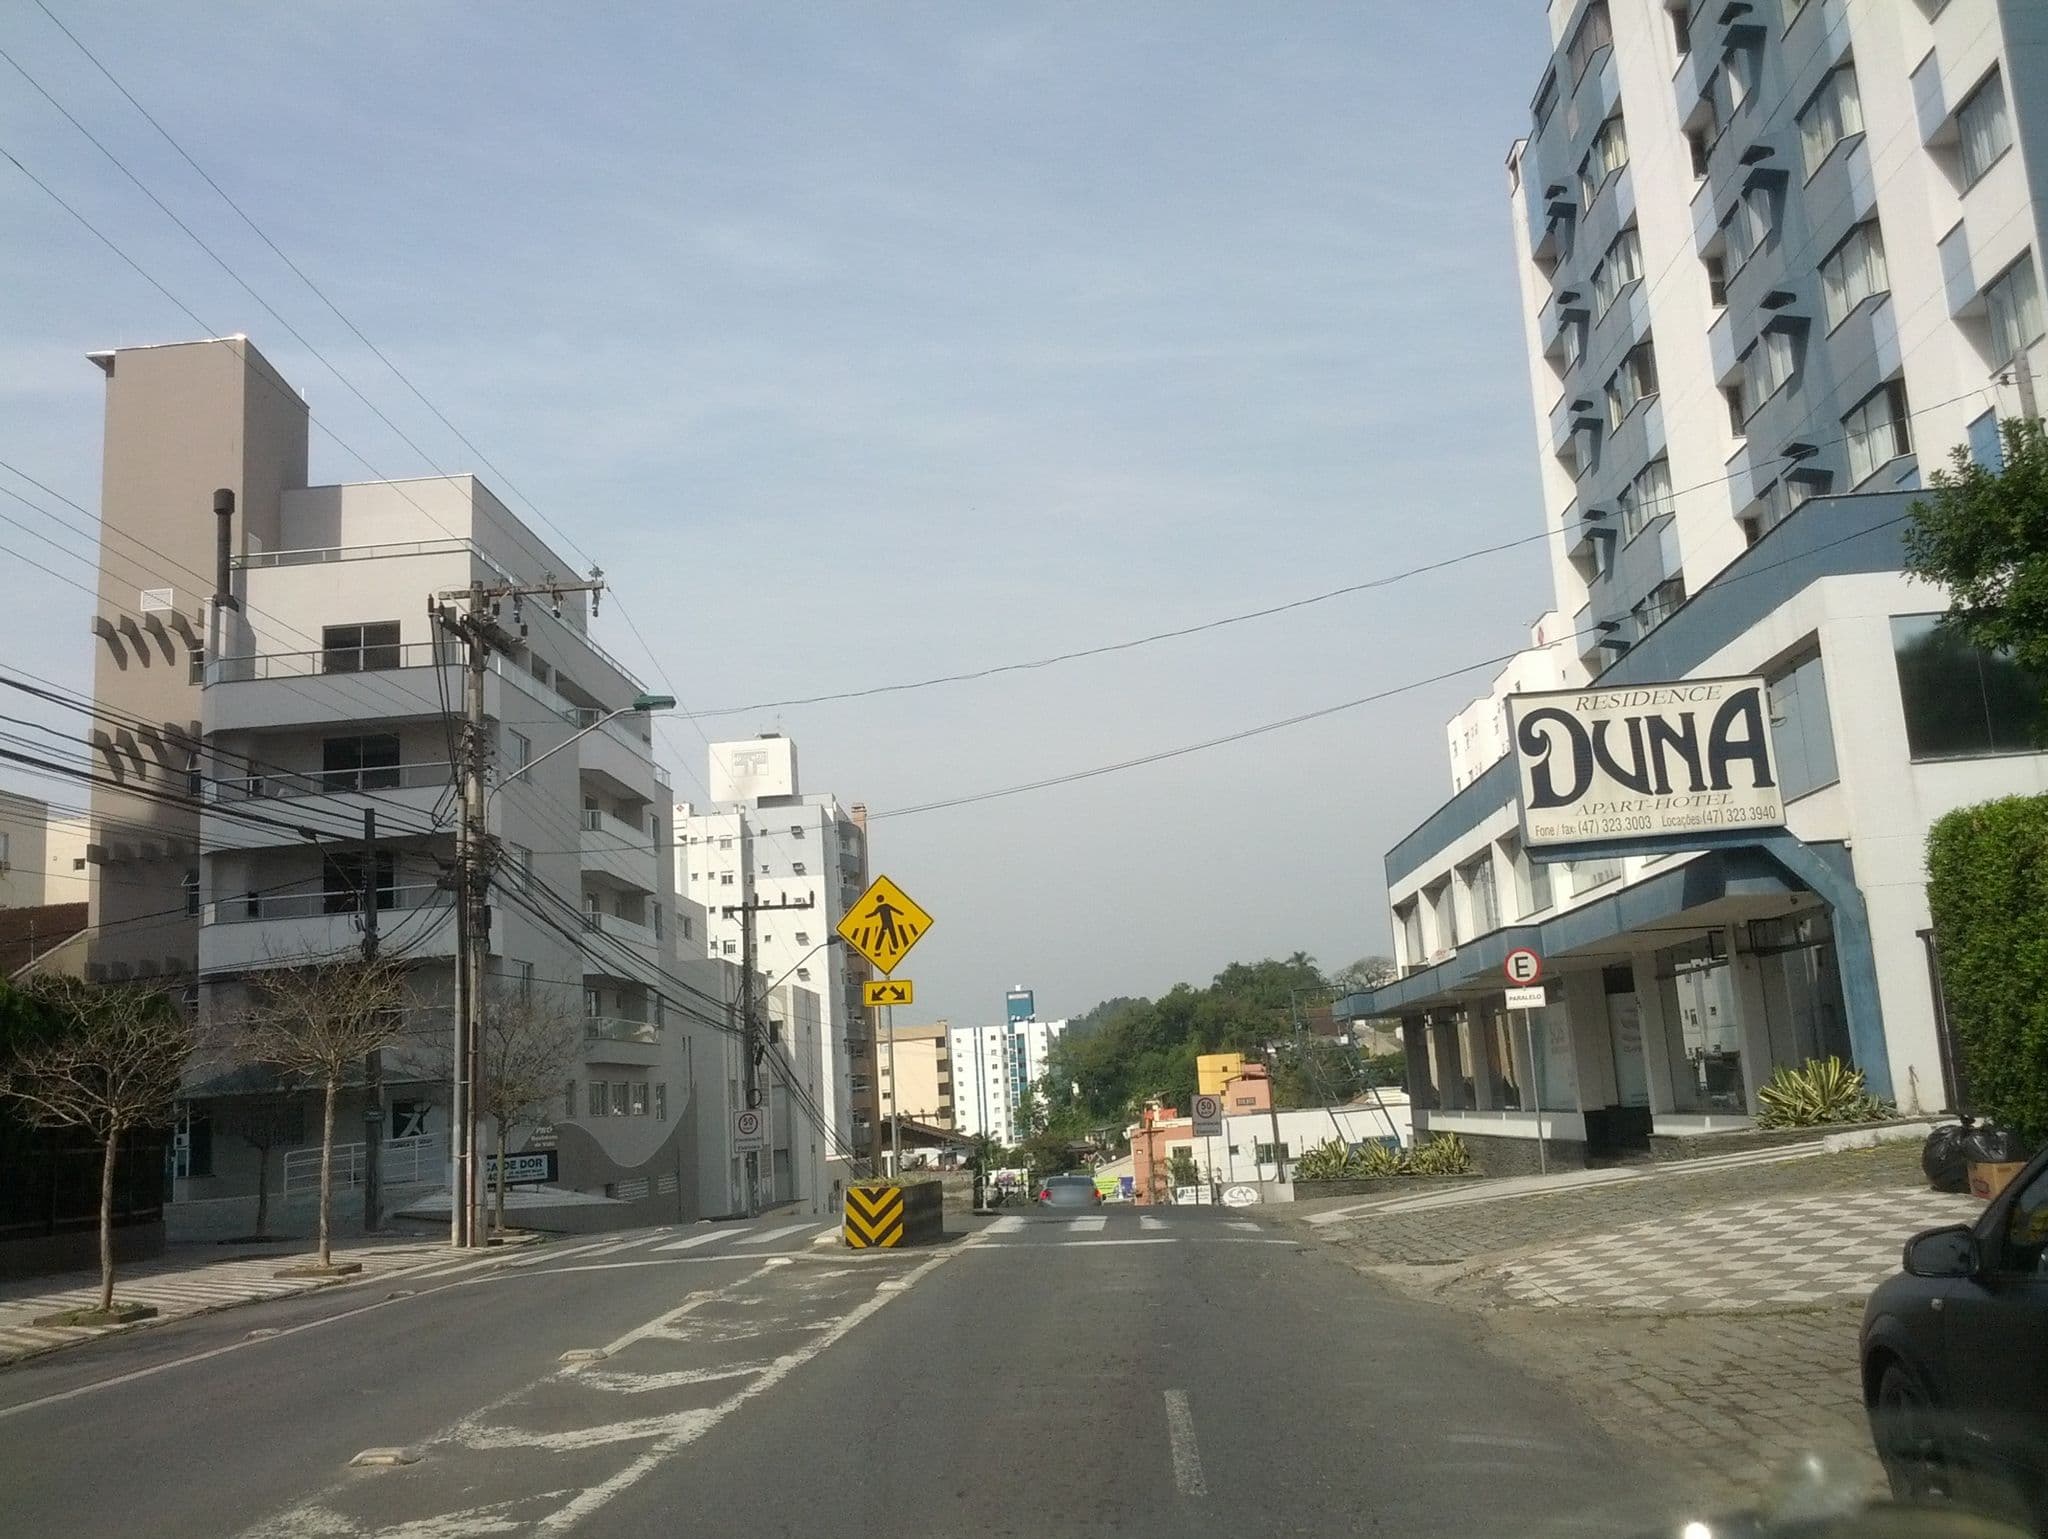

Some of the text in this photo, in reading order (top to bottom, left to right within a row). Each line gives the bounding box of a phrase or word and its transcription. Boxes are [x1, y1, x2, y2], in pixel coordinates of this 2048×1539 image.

[1575, 685, 1723, 712] RESIDENCE
[1518, 687, 1776, 810] DUNA
[1576, 793, 1734, 816] APART-HOTEL
[1535, 825, 1555, 837] Fone
[1578, 819, 1599, 835] (47)
[1601, 815, 1652, 833] 323.3003
[1702, 809, 1723, 825] (47)
[1726, 805, 1776, 823] 323.3940
[1514, 956, 1530, 978] E
[1509, 993, 1542, 1001] PARALELO
[1201, 1101, 1212, 1110] 50
[520, 1158, 543, 1169] DOR
